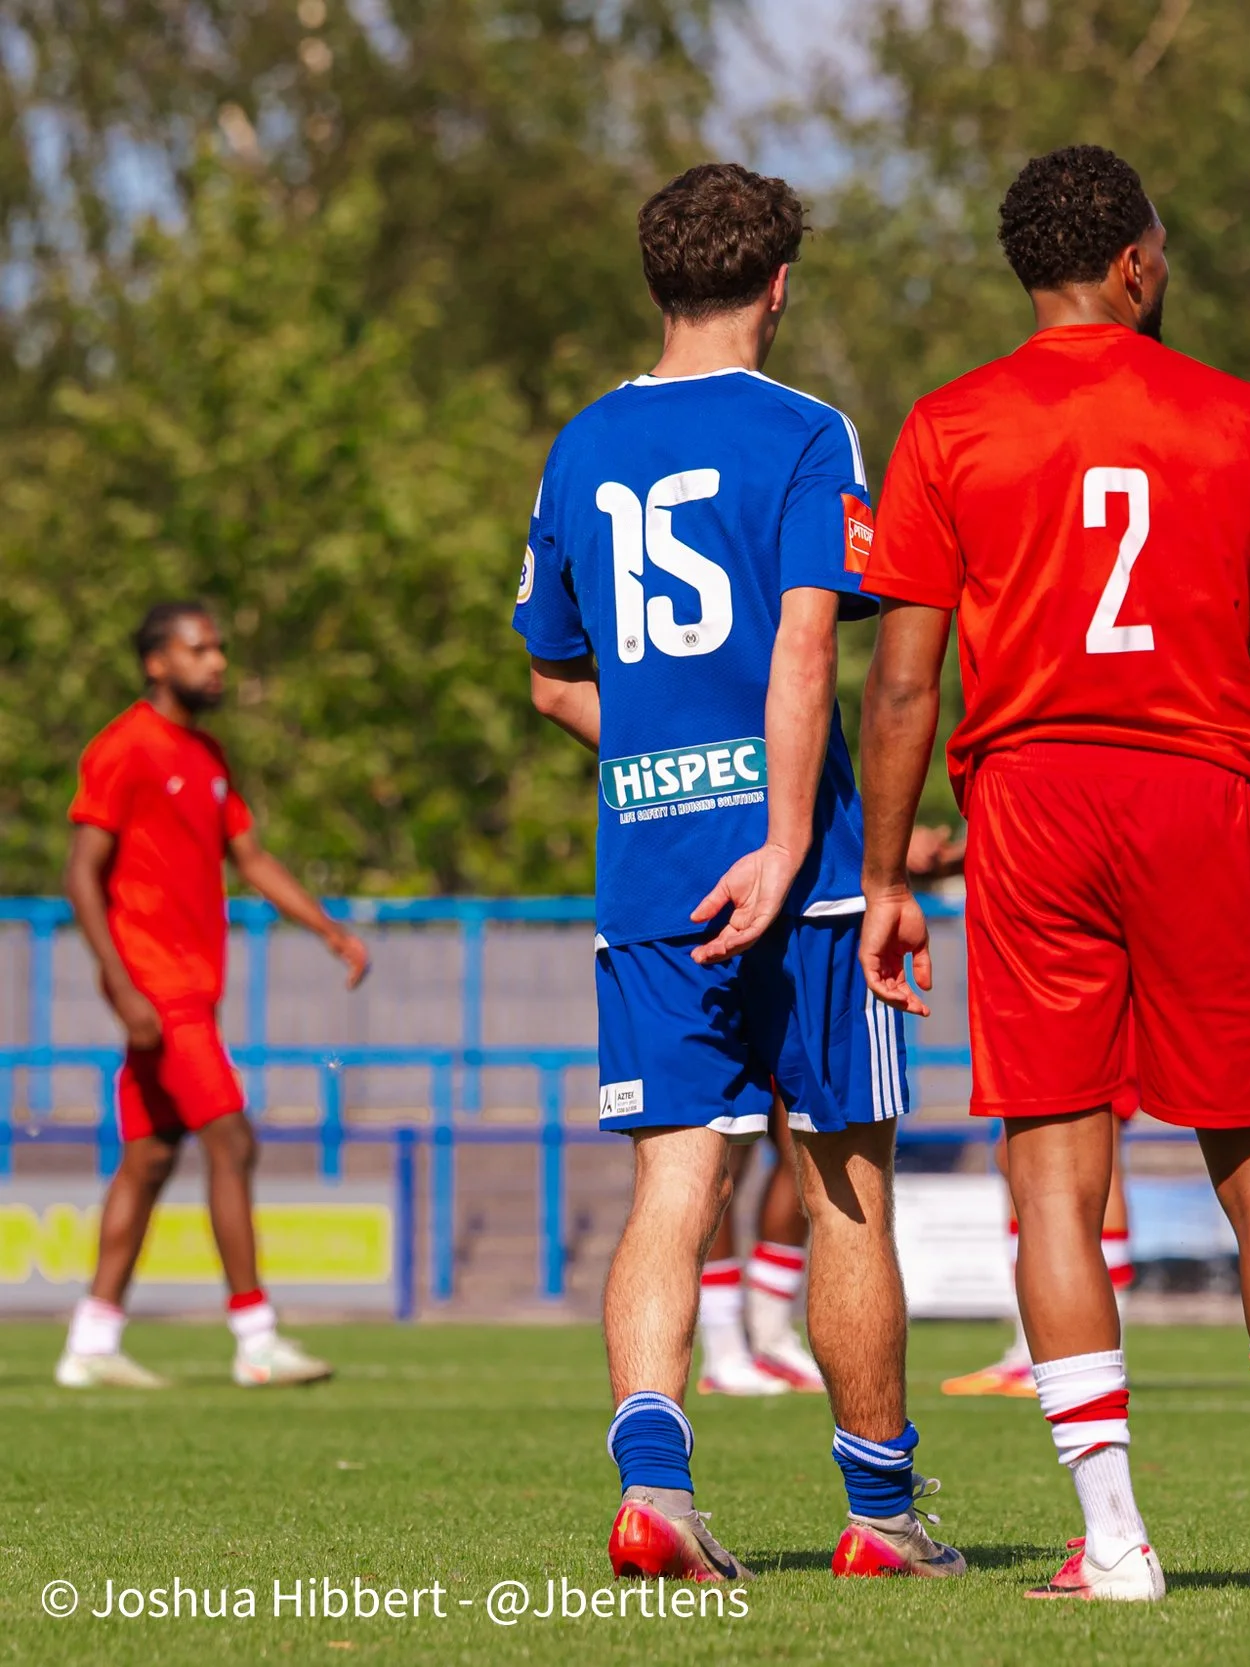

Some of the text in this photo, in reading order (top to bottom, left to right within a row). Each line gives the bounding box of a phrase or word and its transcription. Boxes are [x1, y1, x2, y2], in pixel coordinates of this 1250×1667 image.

[595, 468, 734, 664] 15
[1082, 466, 1155, 655] 2
[612, 744, 760, 807] HiSPEC
[619, 791, 765, 825] LIFE SAFETY & HOUSING SOLUTIONS
